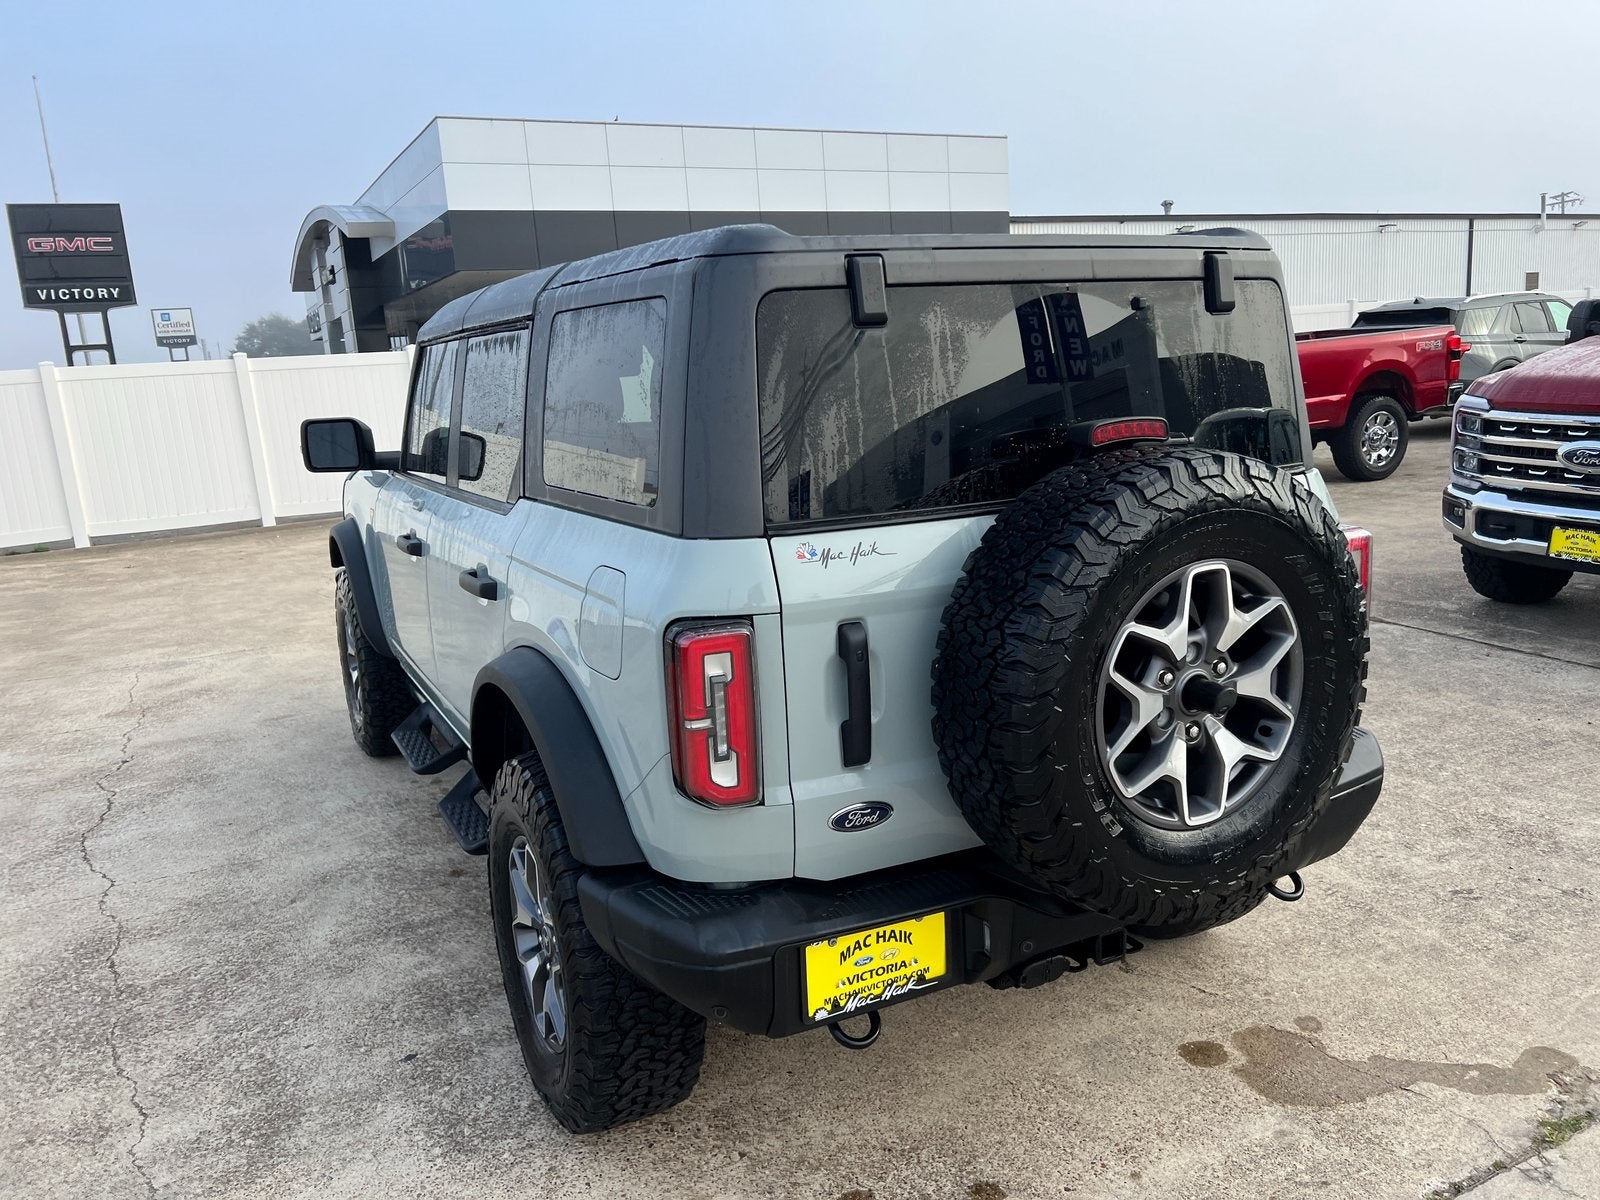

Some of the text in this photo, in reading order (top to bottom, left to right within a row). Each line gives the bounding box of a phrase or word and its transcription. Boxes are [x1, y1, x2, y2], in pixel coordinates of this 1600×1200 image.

[27, 237, 114, 252] GMC
[37, 287, 120, 301] VICTORY
[157, 321, 191, 329] Certified
[1416, 339, 1442, 352] FX4
[1565, 533, 1597, 544] MAC HAIK
[808, 541, 893, 569] Mac Haik
[844, 808, 880, 828] Ford
[839, 929, 913, 966] MAC HAIK
[846, 960, 908, 985] VICTORIA
[824, 966, 930, 1006] MACHAIKVICTORIA.COM
[838, 980, 934, 1013] Mac Haik
